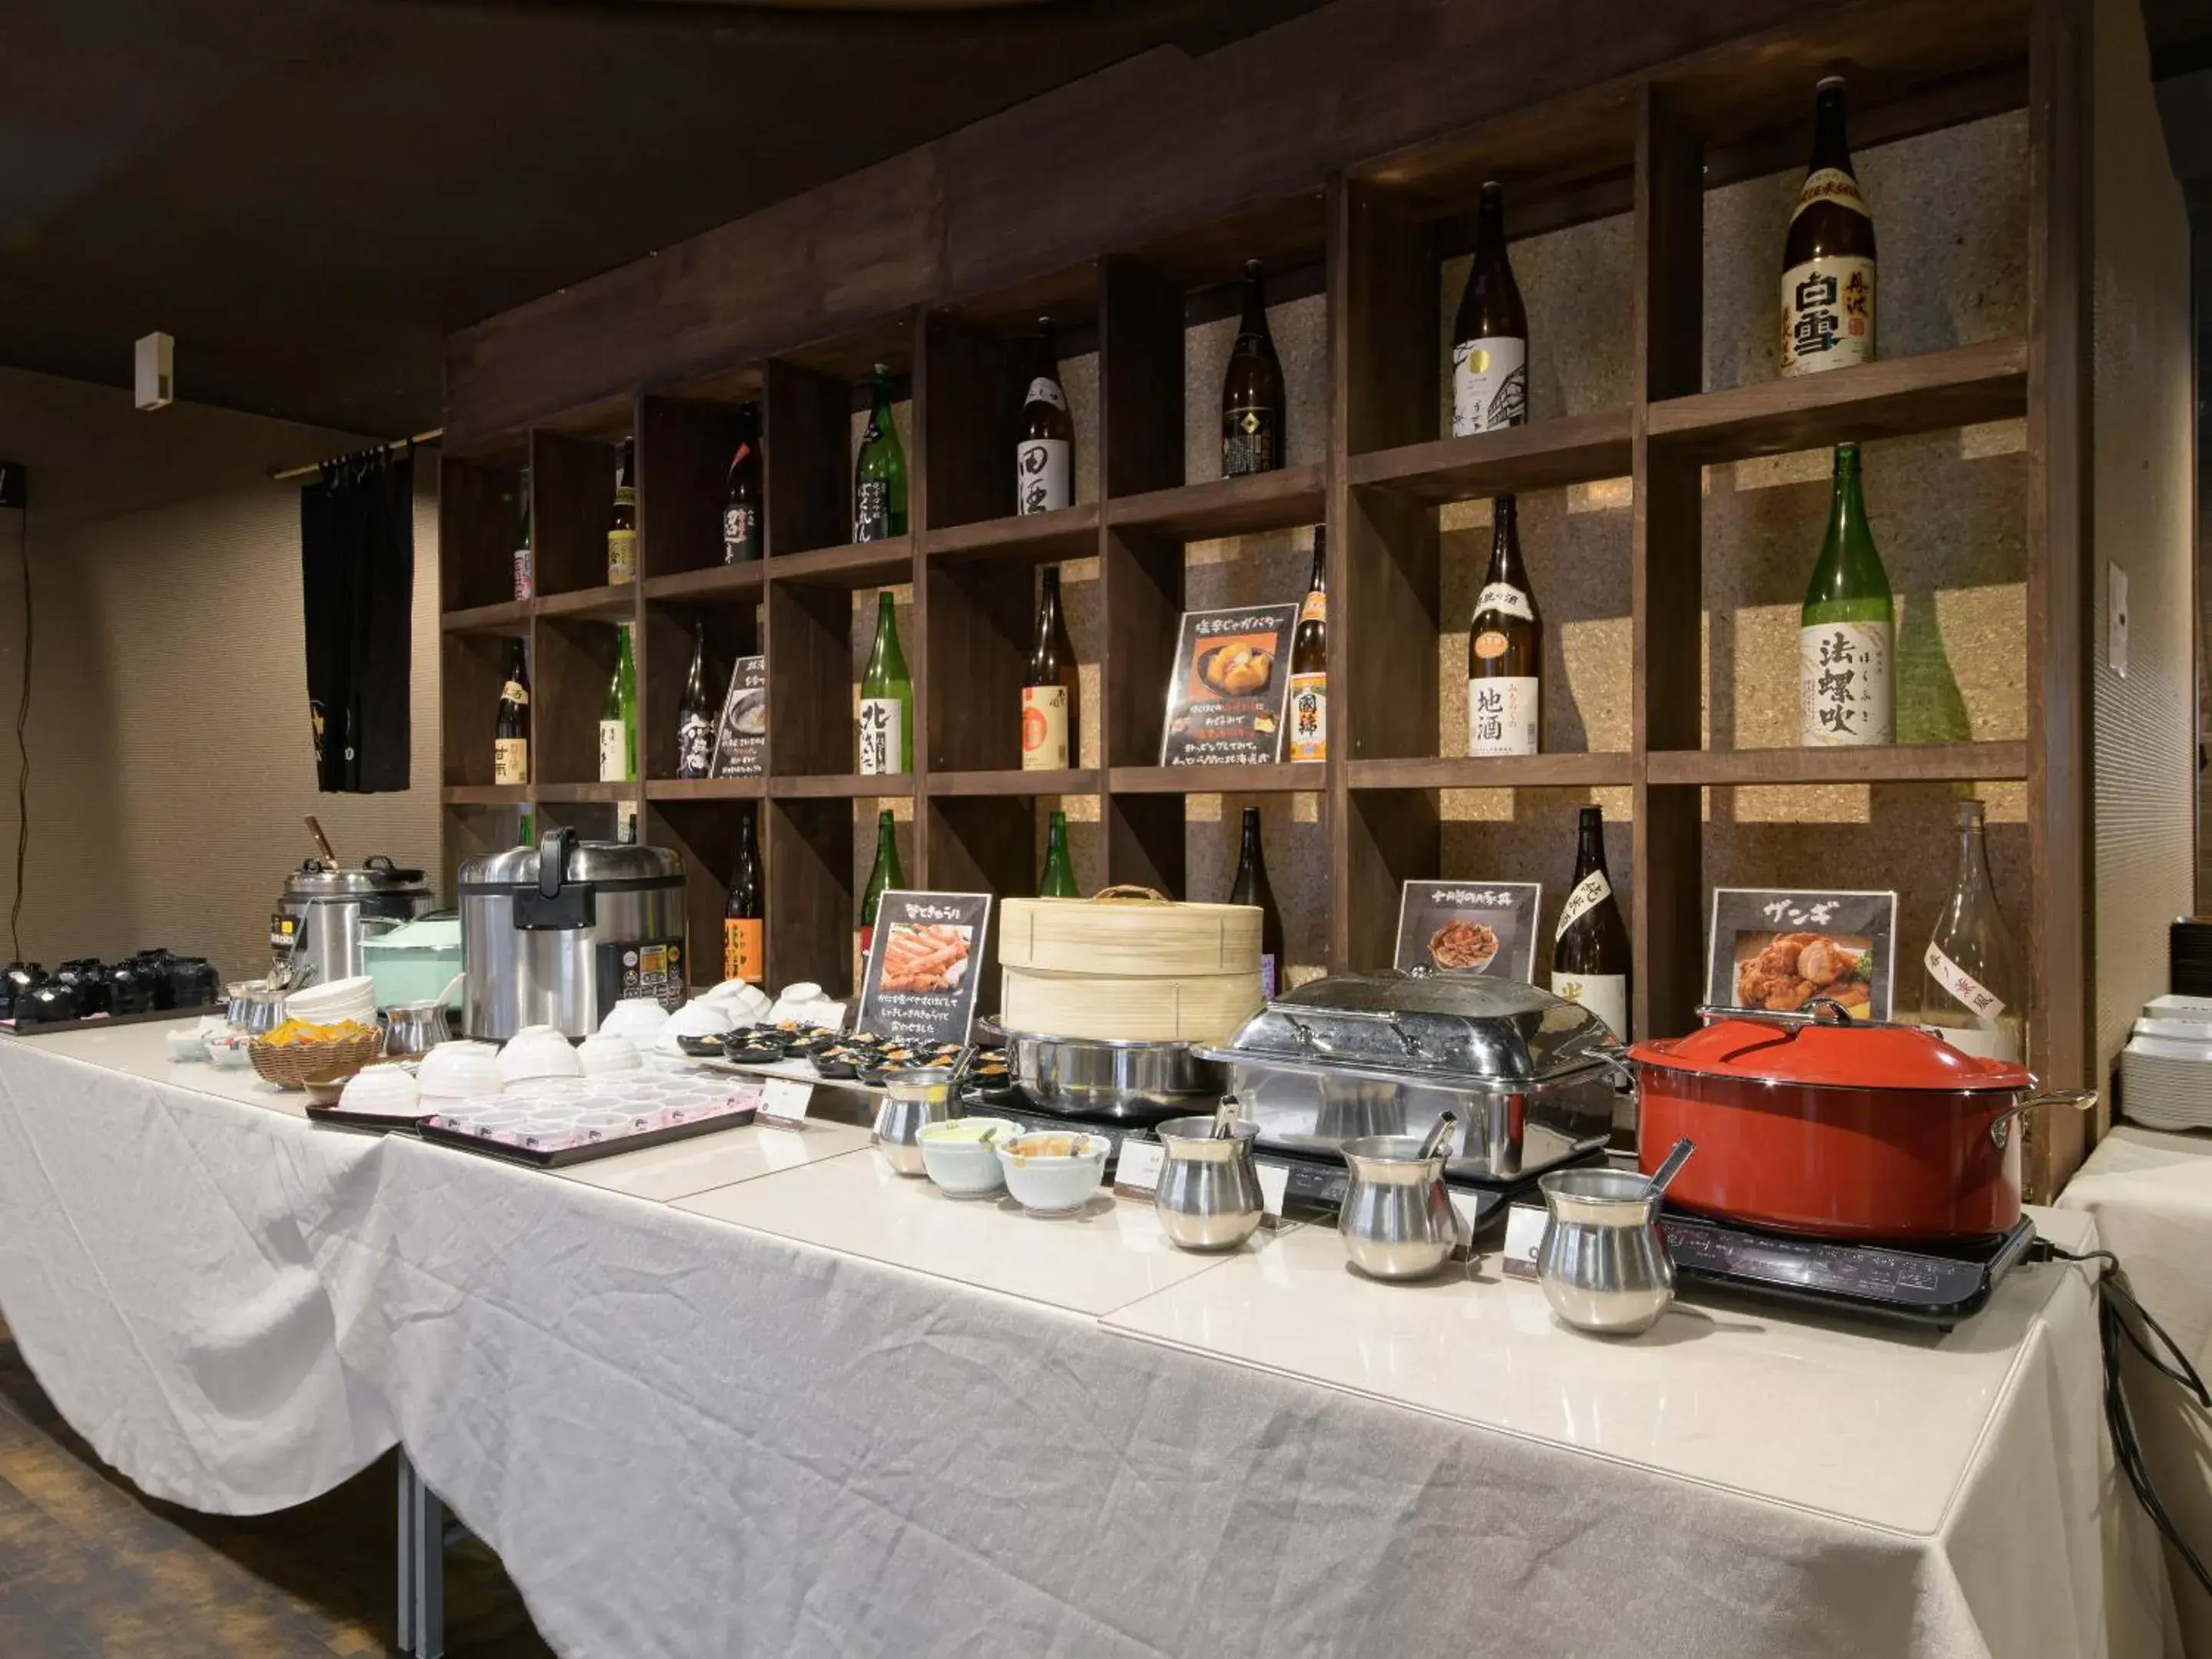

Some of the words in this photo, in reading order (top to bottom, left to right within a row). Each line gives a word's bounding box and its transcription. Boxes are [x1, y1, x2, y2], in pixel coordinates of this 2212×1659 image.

[1793, 272, 1841, 356] 白雪
[1476, 687, 1504, 741] 地酒
[1817, 631, 1858, 736] 法螺吹
[1763, 898, 1840, 926] ザンギ
